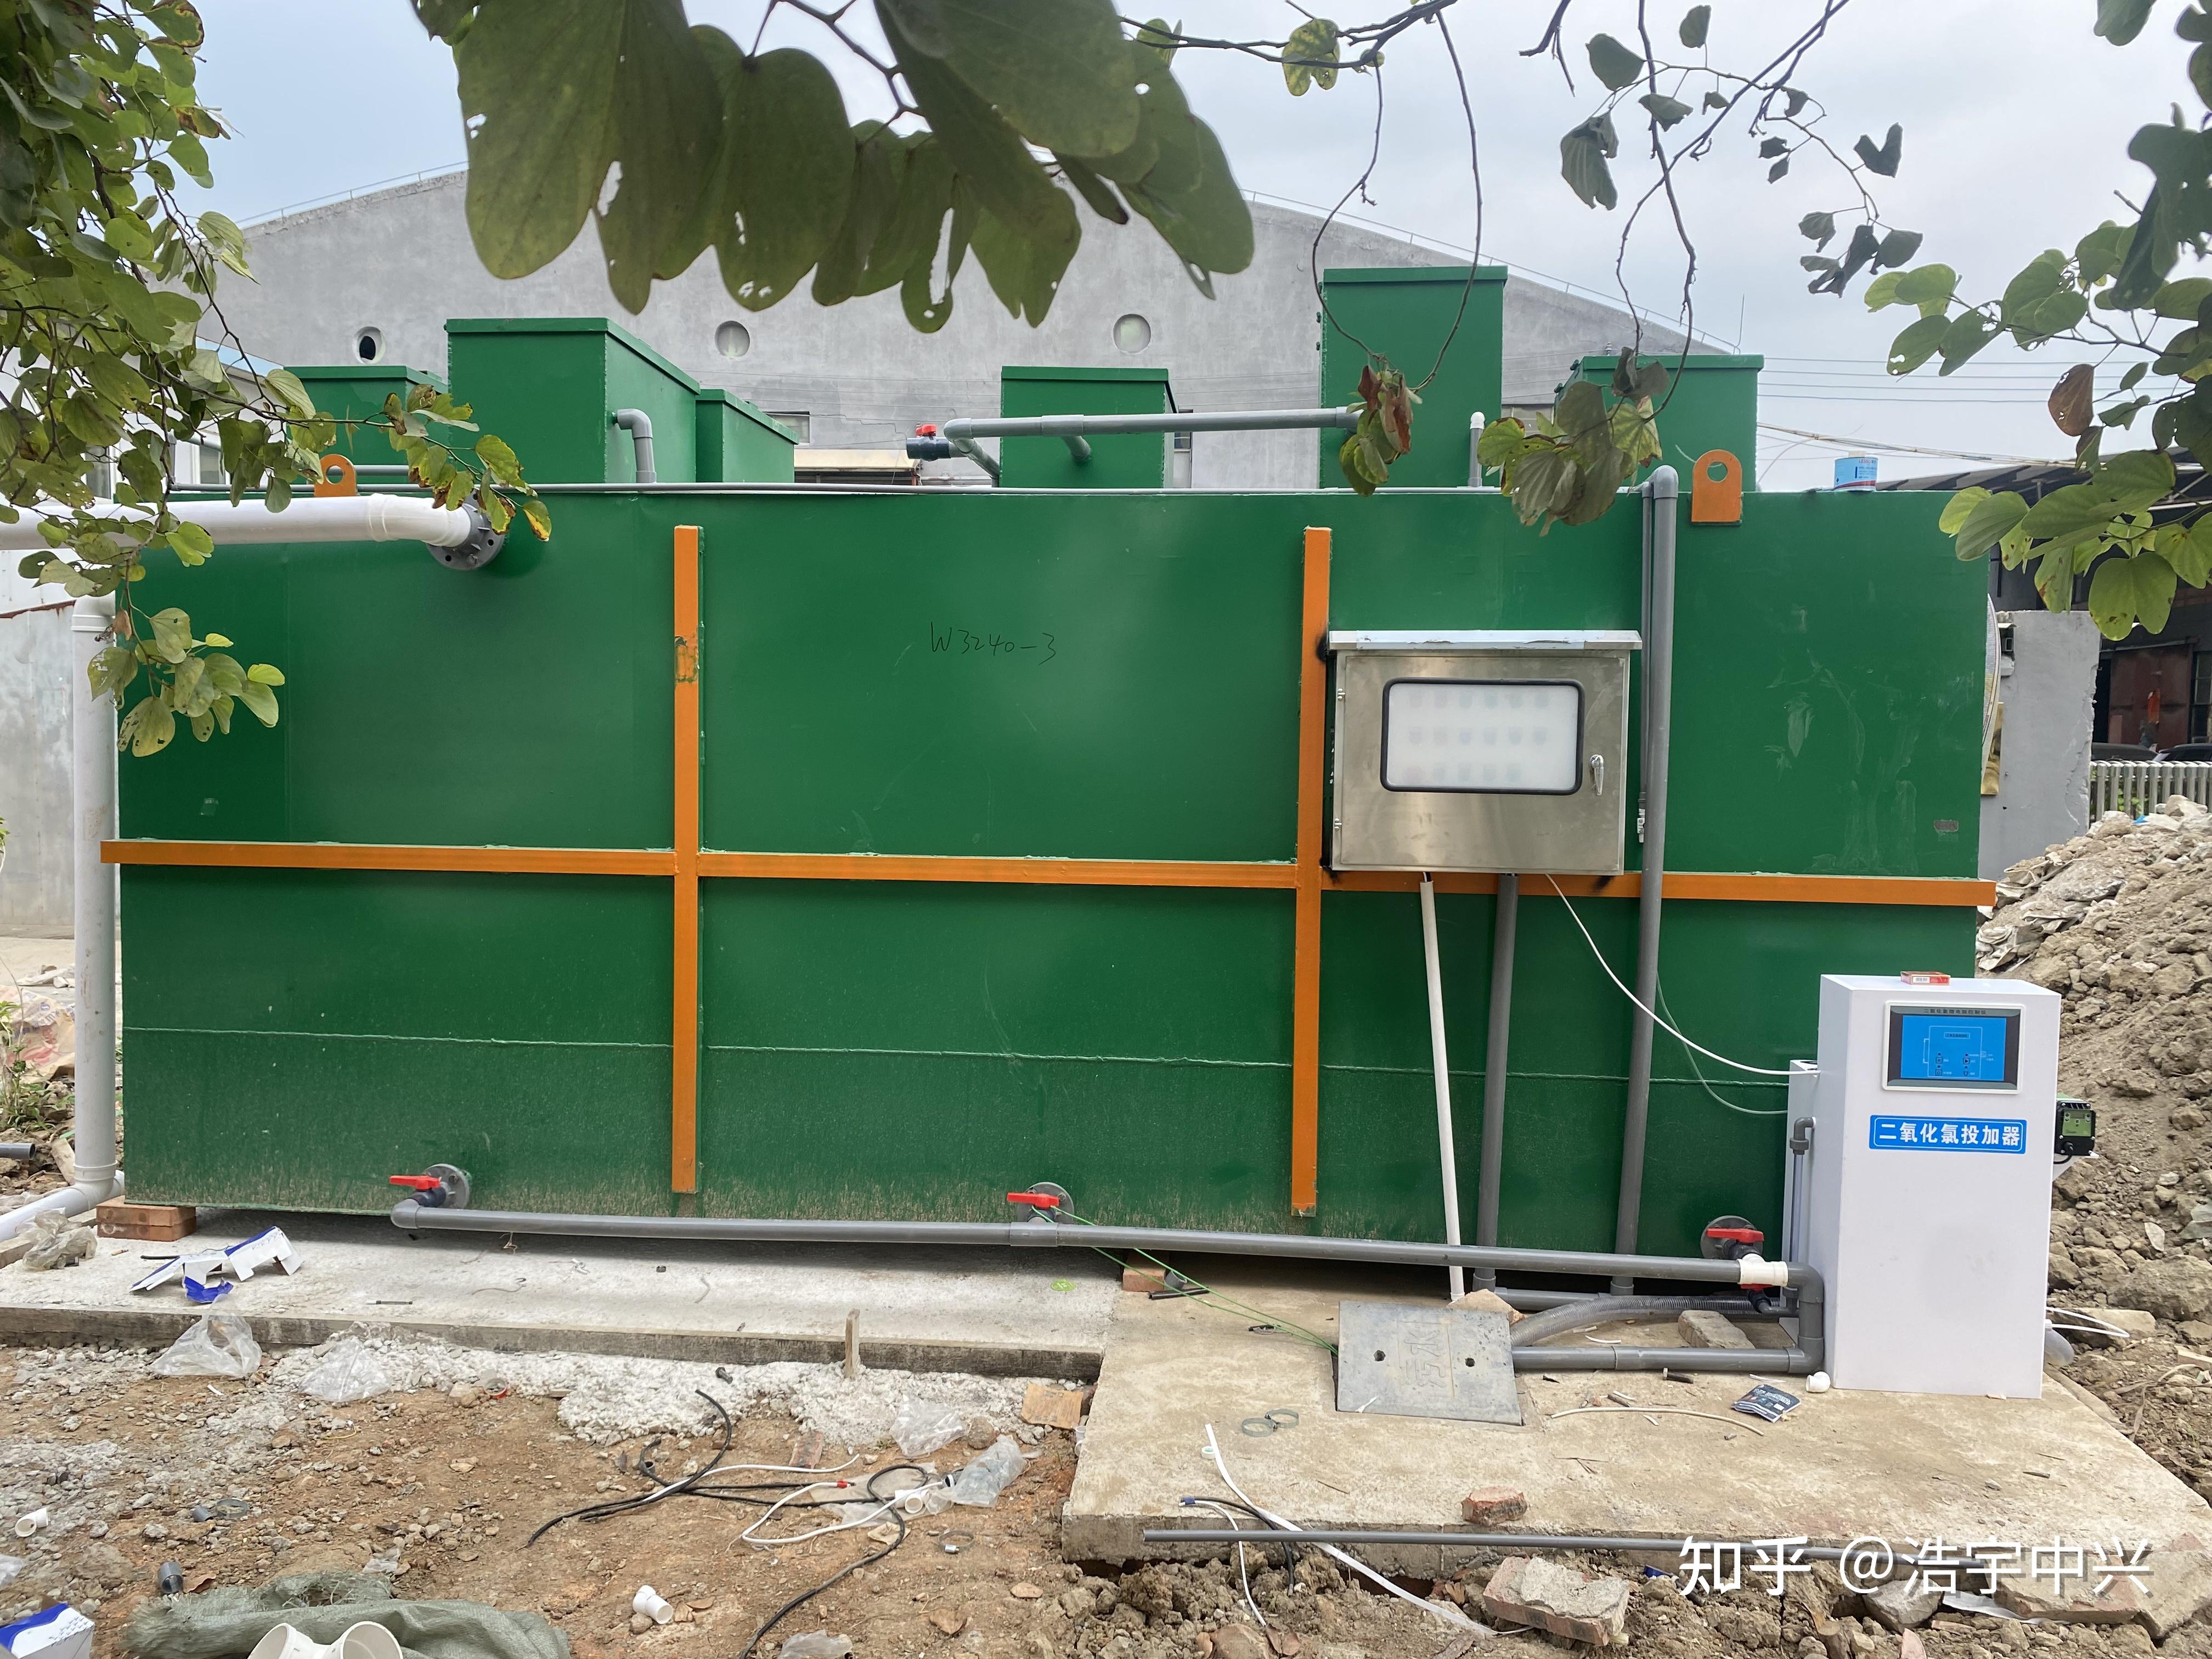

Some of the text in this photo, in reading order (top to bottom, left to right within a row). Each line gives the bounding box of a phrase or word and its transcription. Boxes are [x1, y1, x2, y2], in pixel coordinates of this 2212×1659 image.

[1879, 1122, 2020, 1146] 二氧化氯投加器
[1401, 1329, 1447, 1388] 污水
